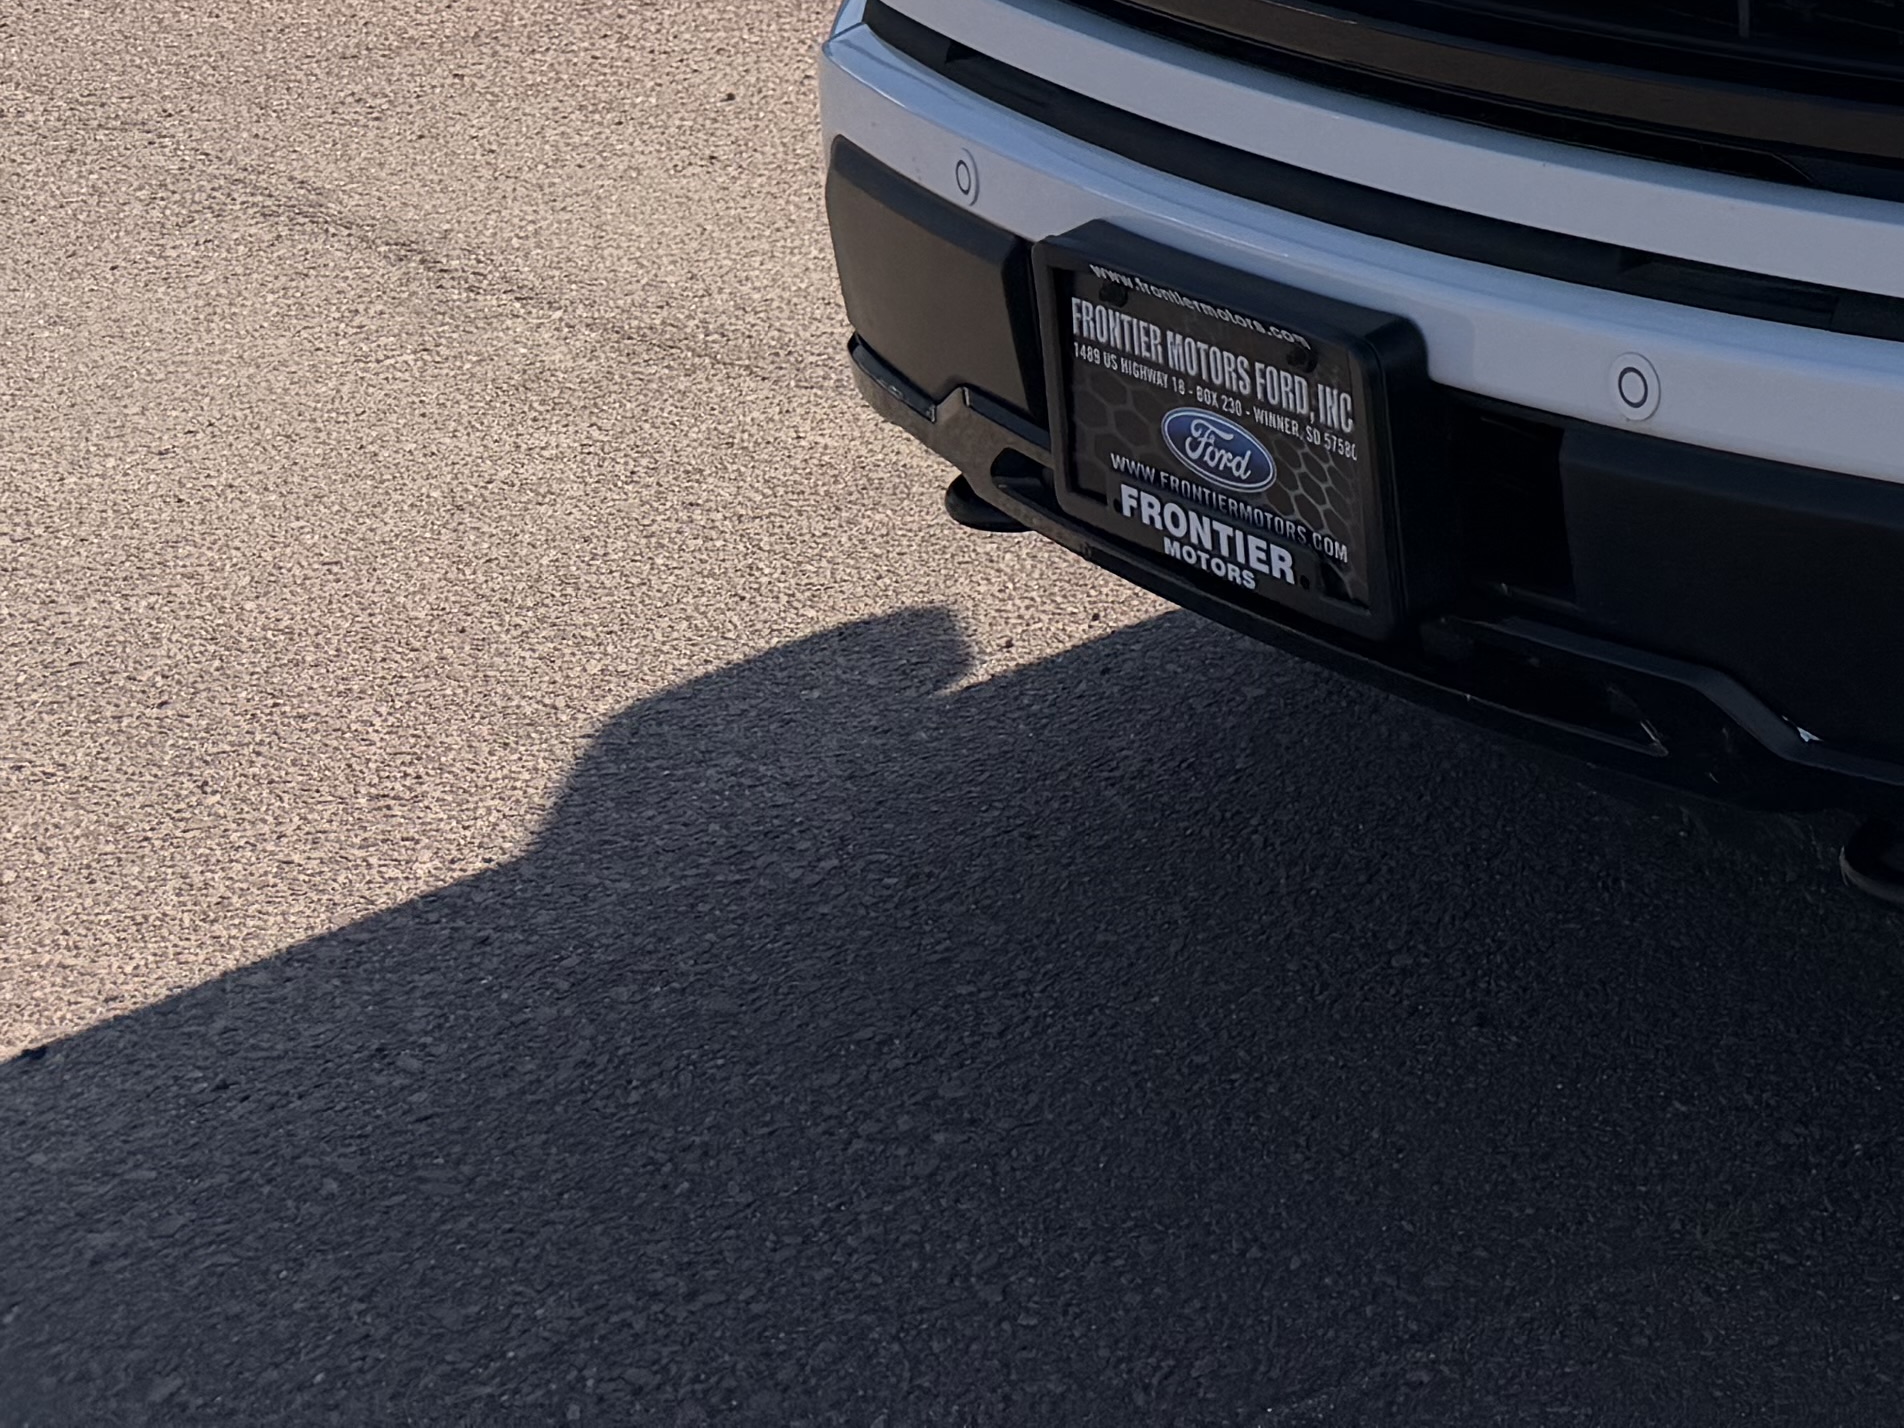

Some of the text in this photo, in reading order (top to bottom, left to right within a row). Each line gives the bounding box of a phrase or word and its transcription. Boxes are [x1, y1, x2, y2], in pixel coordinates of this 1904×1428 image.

[1071, 297, 1354, 433] FRONTIER MOTORS FORD, INC
[1074, 342, 1101, 365] 1489
[1103, 351, 1118, 370] US
[1121, 357, 1168, 389] HIGHWAY
[1172, 376, 1186, 395] 18
[1196, 385, 1219, 408] BOX
[1221, 395, 1243, 417] 230
[1306, 425, 1321, 446] SD
[1185, 419, 1252, 480] Ford
[1120, 483, 1296, 585] FRONTIER
[1163, 537, 1257, 590] MOTORS
